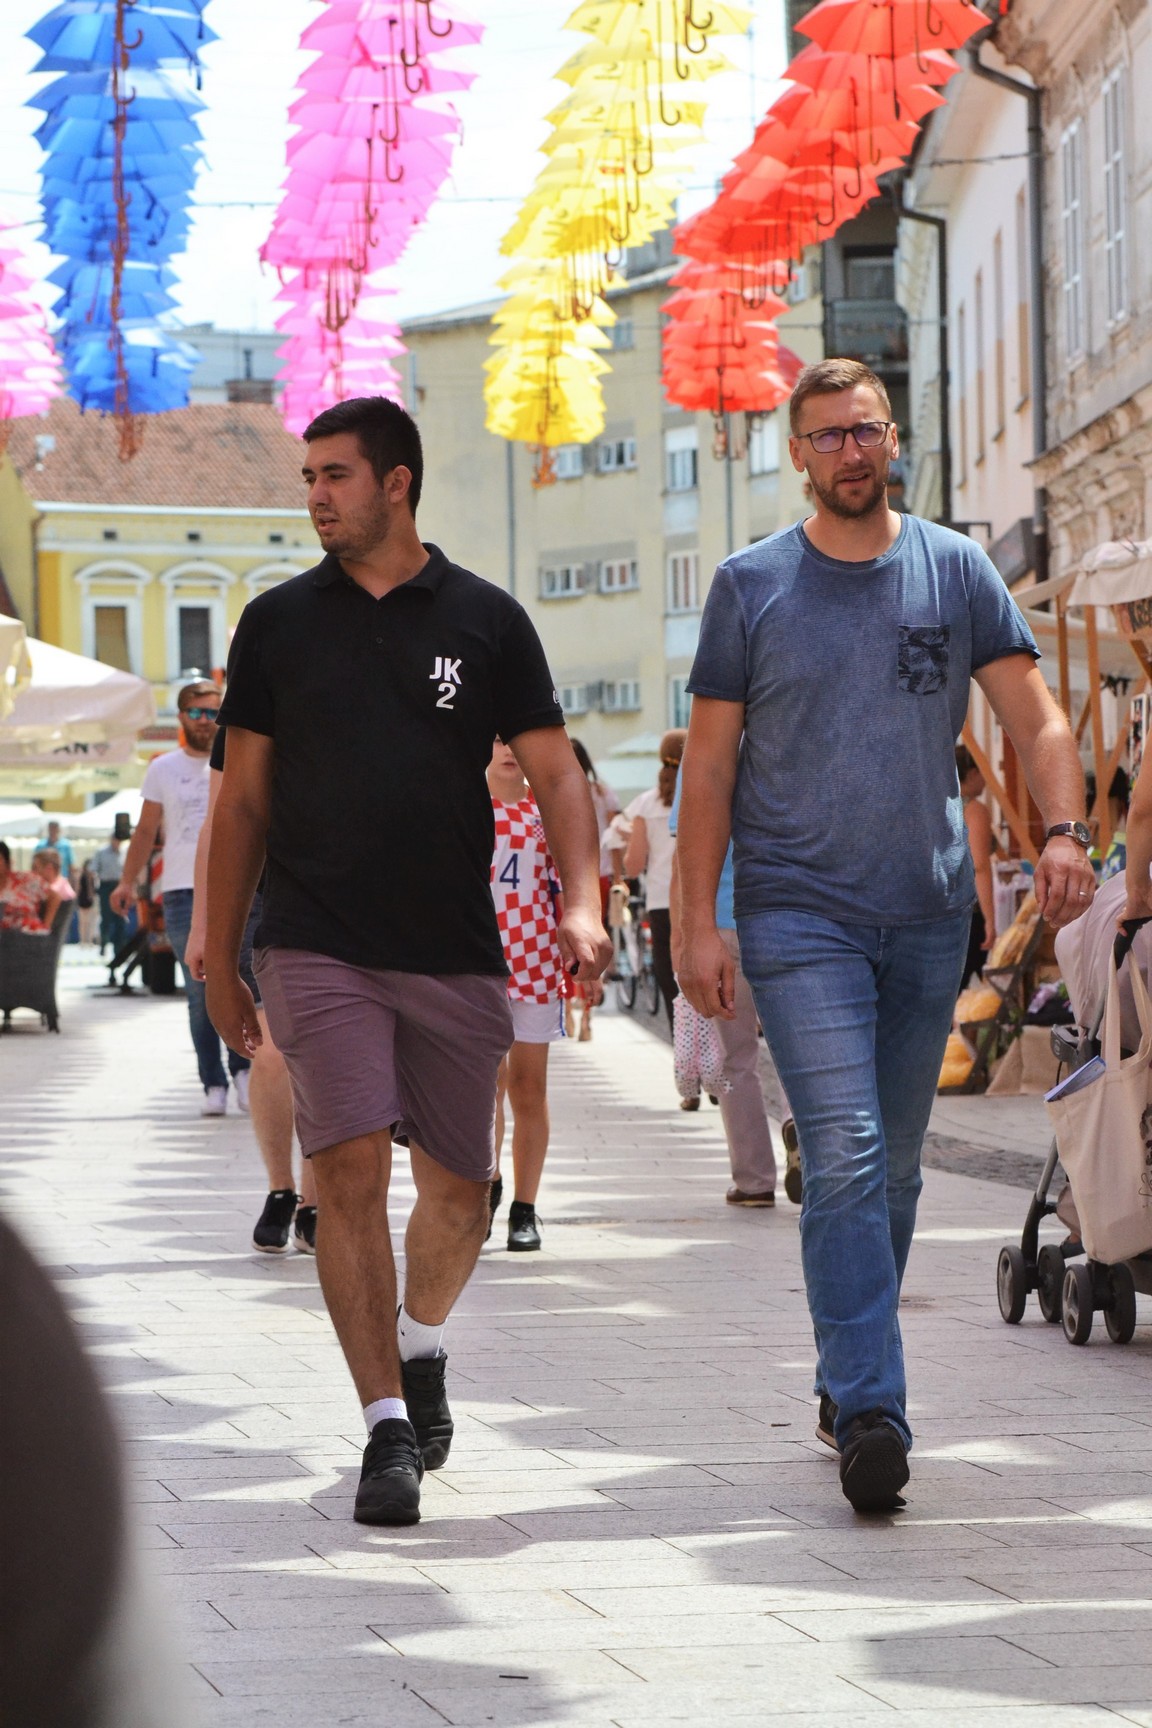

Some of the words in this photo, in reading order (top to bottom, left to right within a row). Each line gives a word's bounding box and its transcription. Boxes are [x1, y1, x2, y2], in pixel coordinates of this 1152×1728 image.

[429, 656, 462, 685] JK
[436, 682, 457, 710] 2
[499, 853, 520, 890] 4
